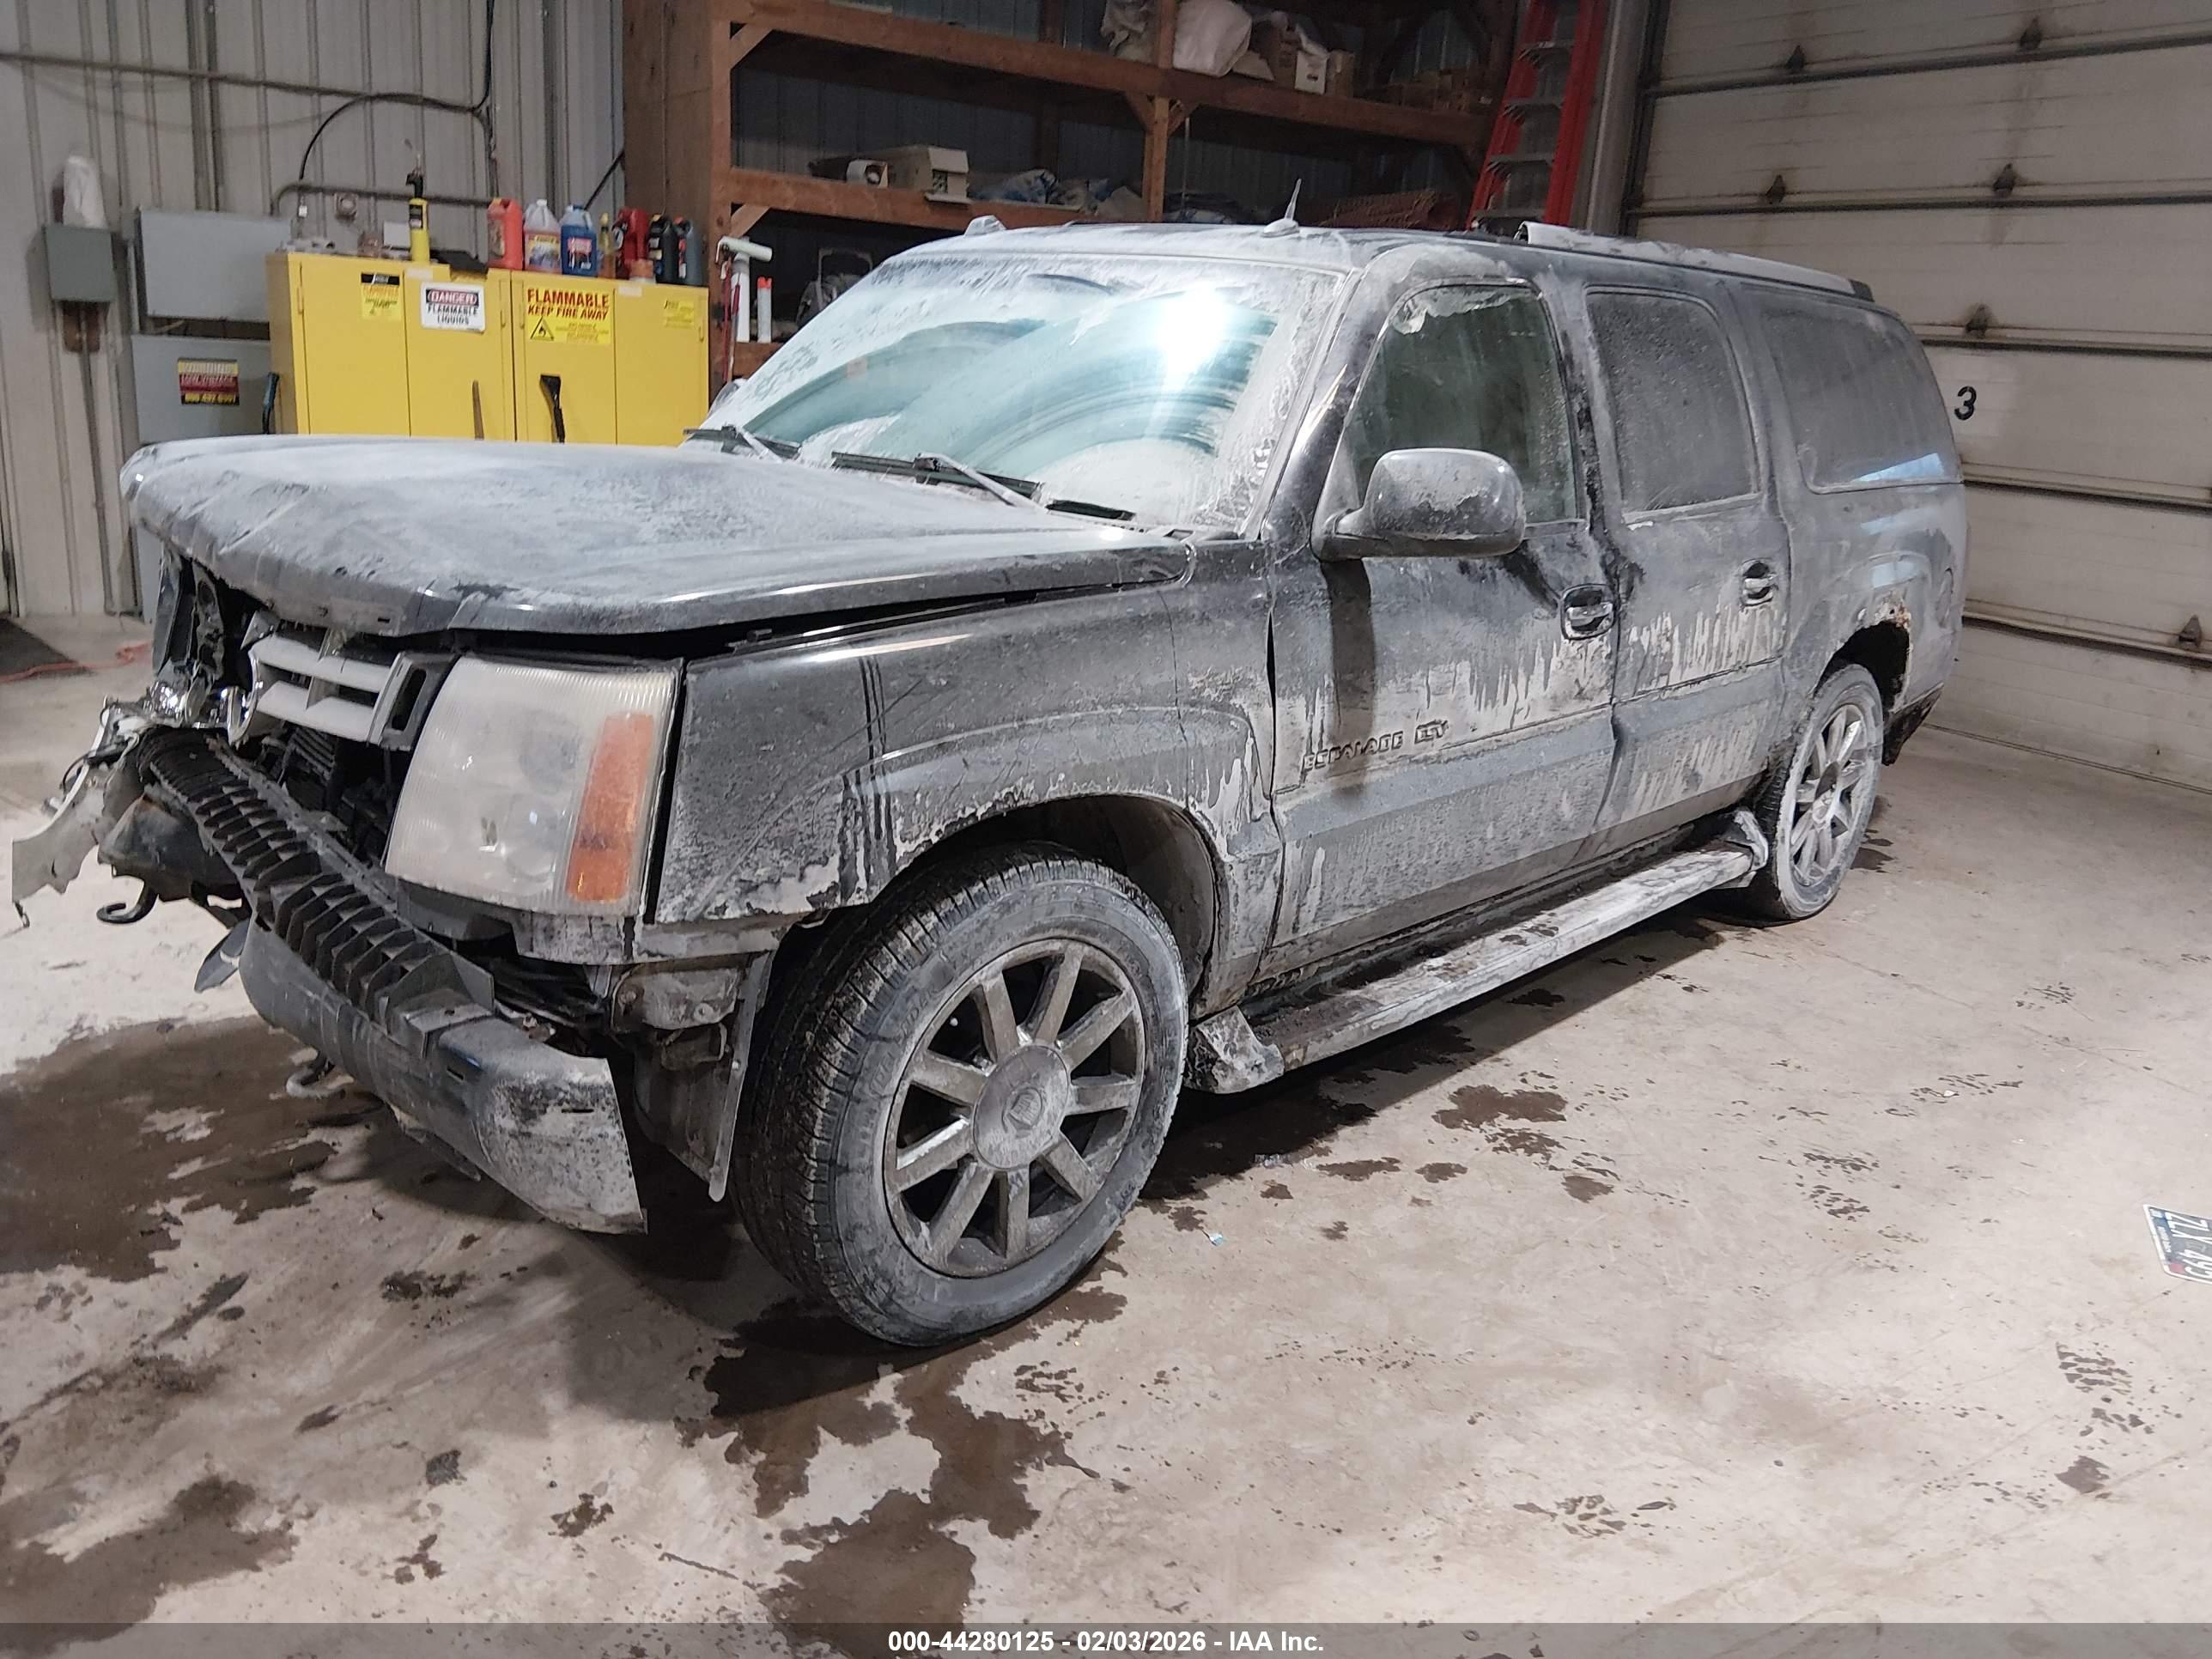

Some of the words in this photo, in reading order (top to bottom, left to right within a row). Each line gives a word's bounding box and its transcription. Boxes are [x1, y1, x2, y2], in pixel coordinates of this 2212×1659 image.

[431, 290, 475, 305] DANGER
[527, 289, 610, 308] FLAMMABLE
[428, 302, 479, 315] FLAMMABLE
[528, 304, 554, 317] KEEP
[556, 307, 578, 319] FIRE
[580, 308, 609, 321] AWAY
[437, 313, 470, 325] LIQUIDS
[1954, 386, 1977, 421] 3
